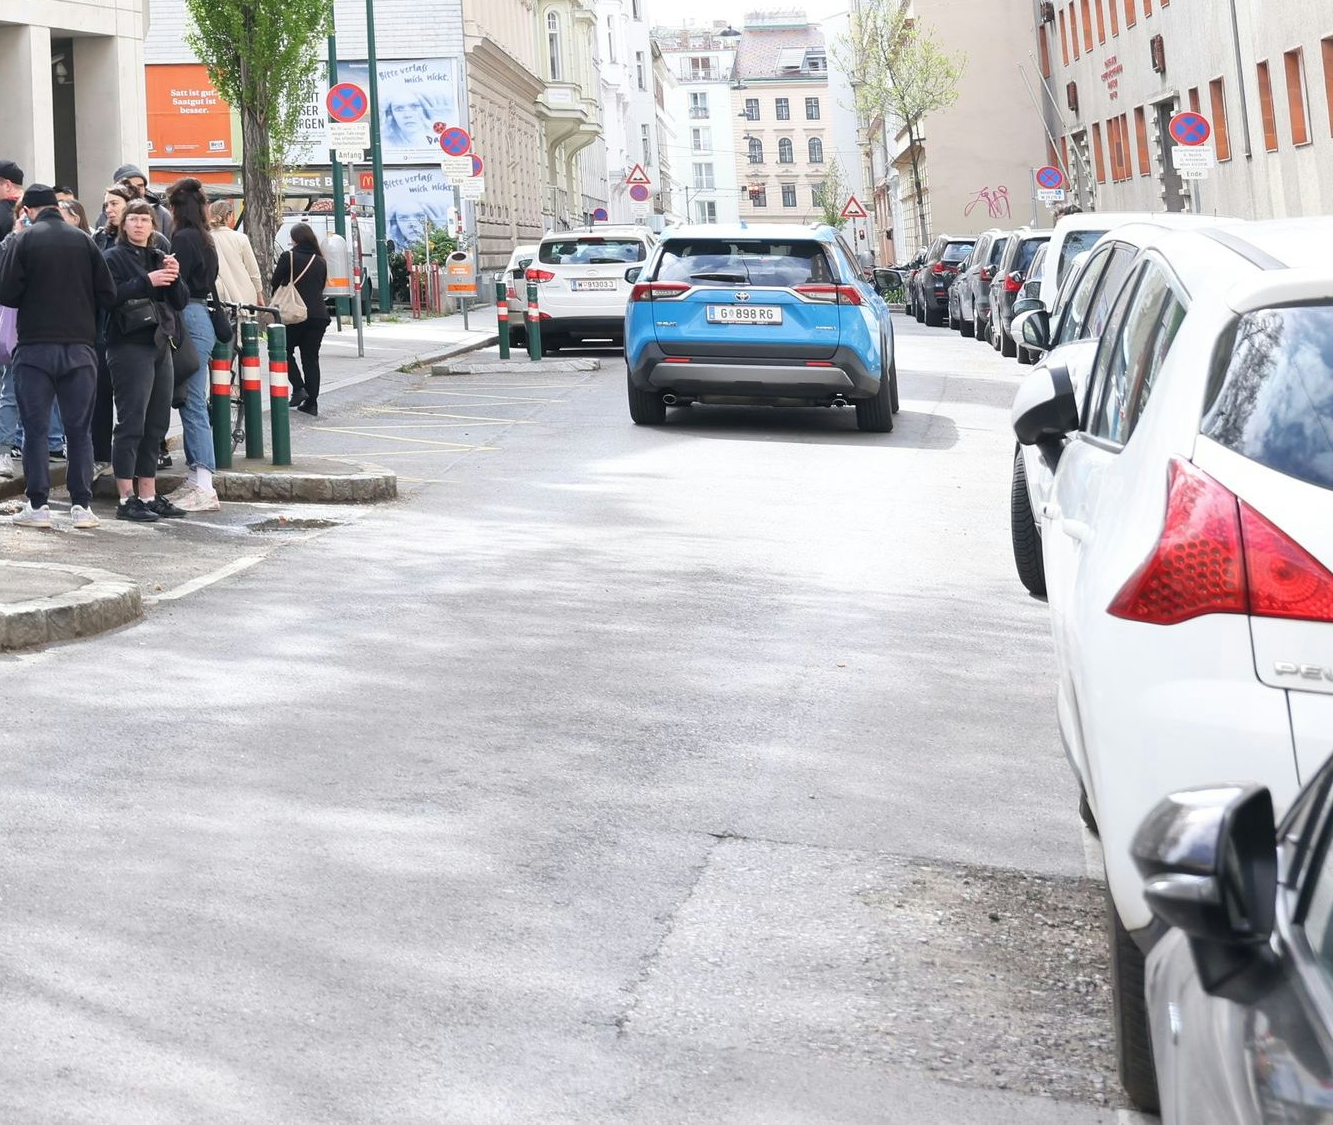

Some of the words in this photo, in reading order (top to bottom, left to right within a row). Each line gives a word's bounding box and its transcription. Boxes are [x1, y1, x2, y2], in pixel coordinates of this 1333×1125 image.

[404, 75, 423, 83] mich
[189, 89, 200, 97] ist
[173, 98, 204, 106] Saatgut
[383, 179, 403, 190] Bitte
[409, 184, 428, 193] mich
[720, 308, 728, 318] G
[735, 308, 757, 319] 898
[759, 309, 774, 319] RG
